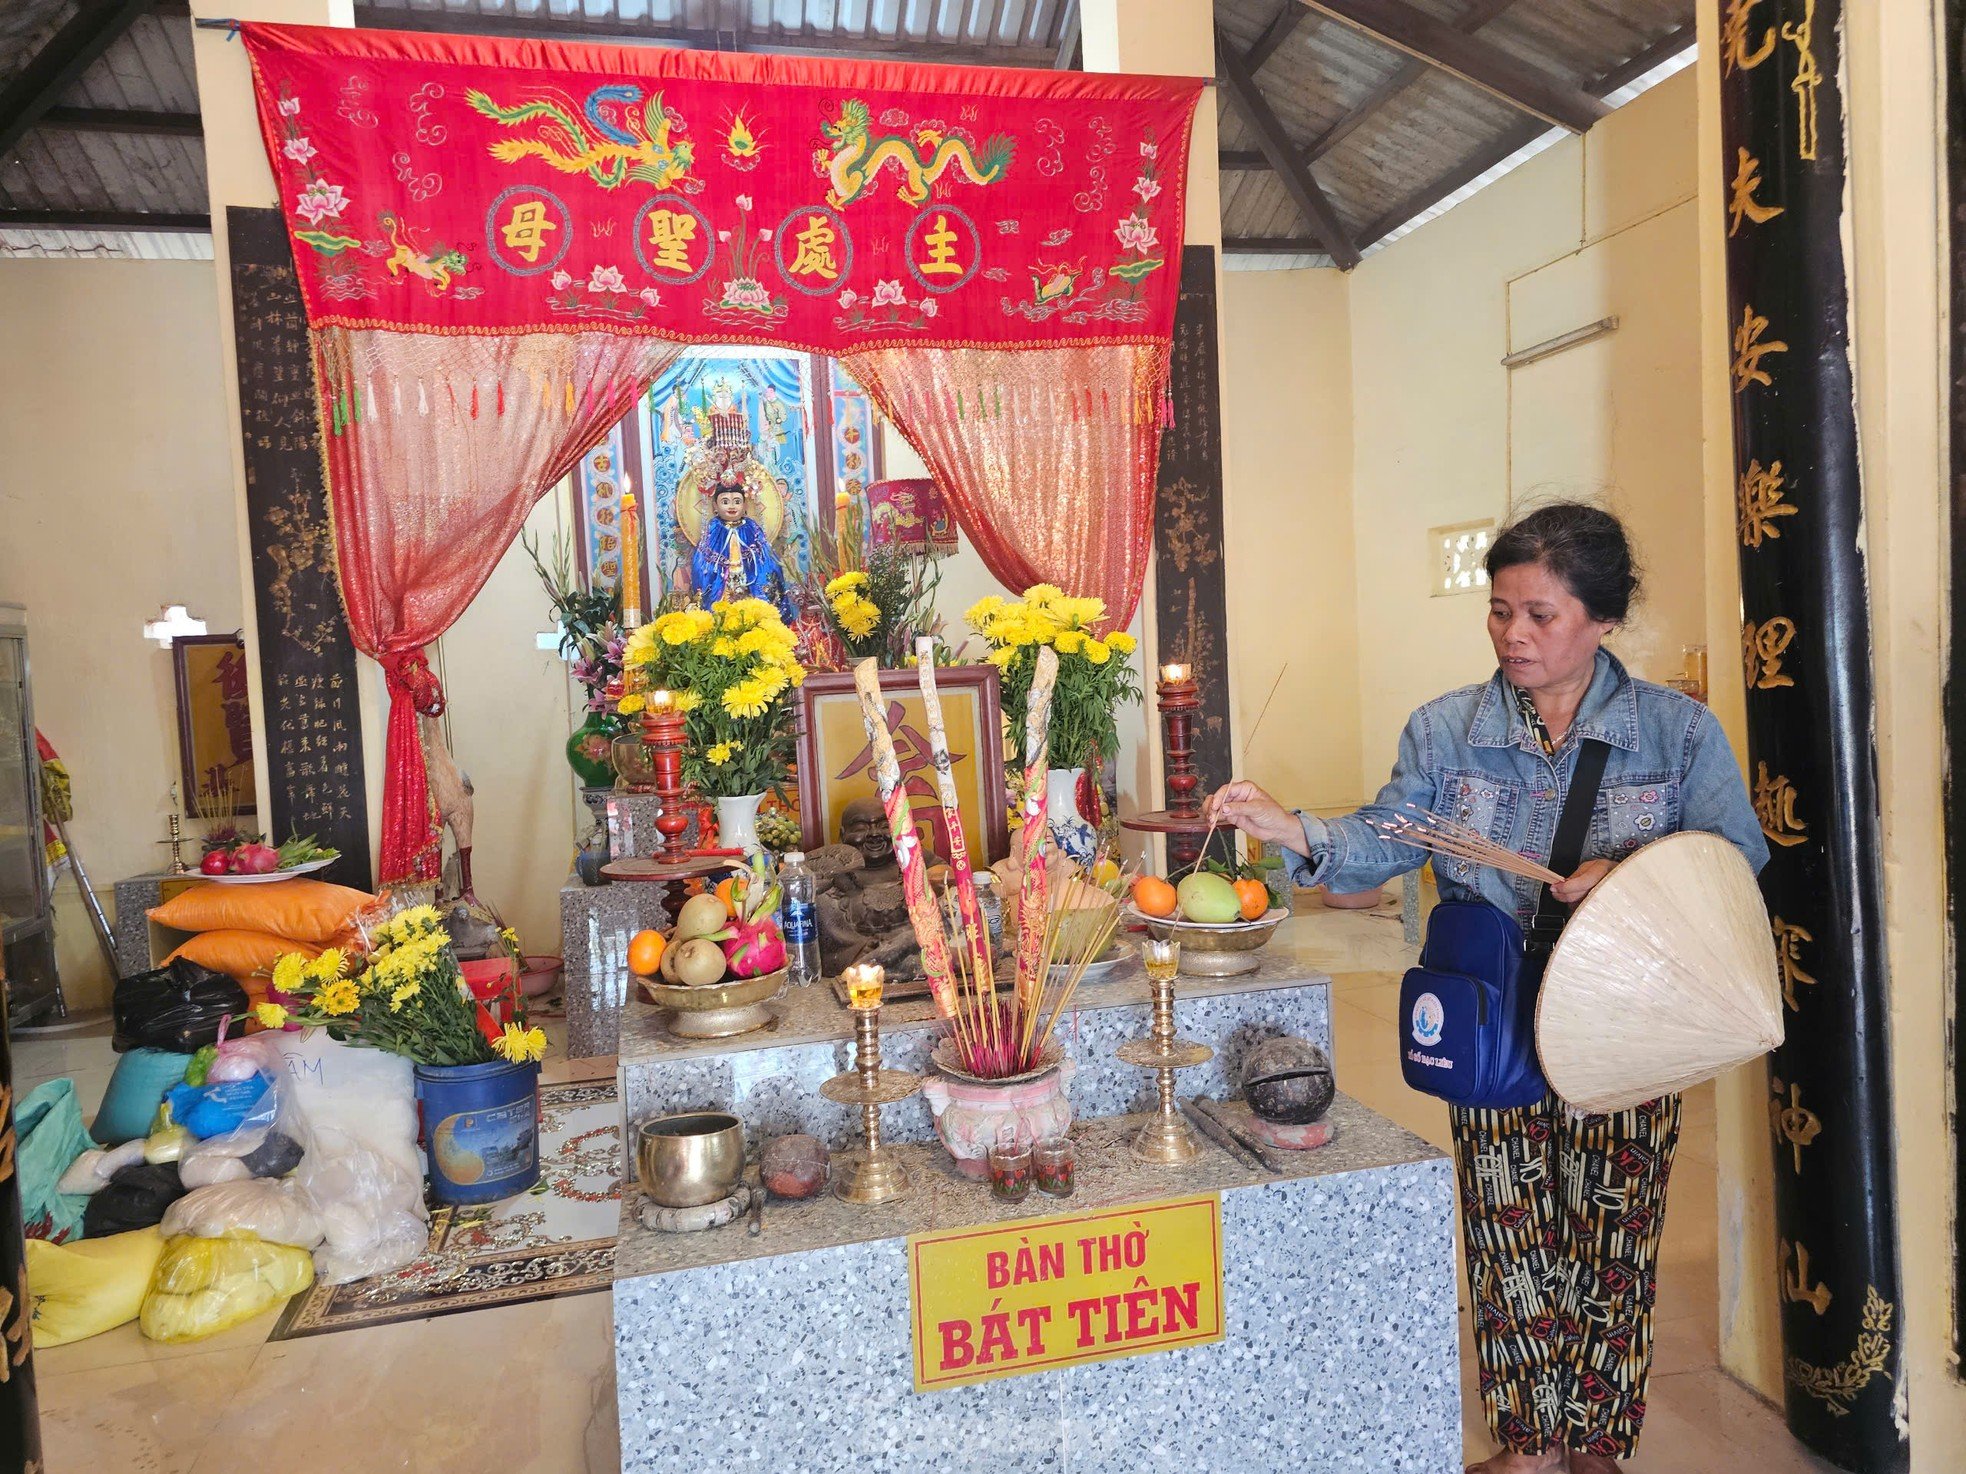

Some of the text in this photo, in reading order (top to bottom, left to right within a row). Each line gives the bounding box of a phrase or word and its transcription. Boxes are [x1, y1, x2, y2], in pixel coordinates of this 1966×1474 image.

[1639, 1115, 1648, 1138] CHANEL
[1478, 1130, 1489, 1153] CHANEL
[1511, 1136, 1521, 1160] CHANEL
[1590, 1154, 1601, 1177] CHANEL
[1620, 1150, 1644, 1173] CK
[1629, 1147, 1650, 1165] Calvin
[1485, 1183, 1495, 1206] CHANEL
[1639, 1177, 1648, 1199] CHANEL
[1621, 1206, 1644, 1223] Calvin
[986, 1220, 1150, 1290] BÀN THỜ
[1624, 1235, 1634, 1258] CHANEL
[1499, 1252, 1512, 1275] CHANEL
[1625, 1294, 1634, 1317] CHANEL
[937, 1275, 1201, 1372] BÁT TIÊN
[1607, 1325, 1630, 1338] Calvin
